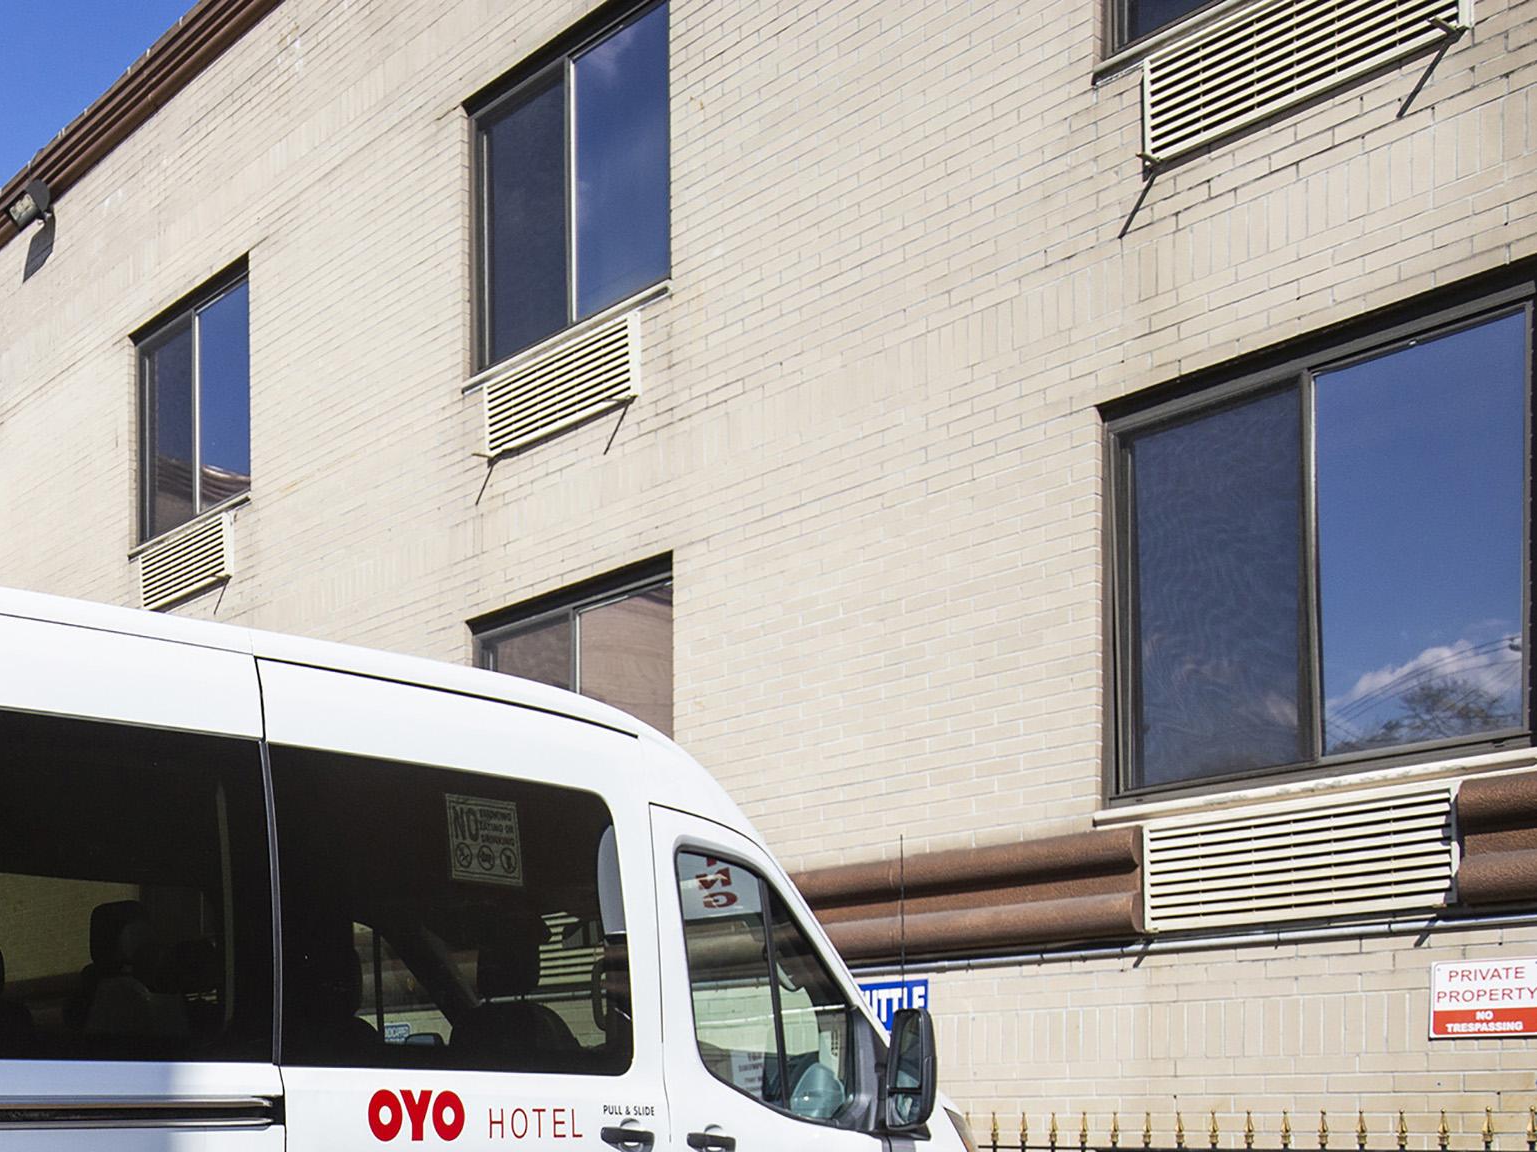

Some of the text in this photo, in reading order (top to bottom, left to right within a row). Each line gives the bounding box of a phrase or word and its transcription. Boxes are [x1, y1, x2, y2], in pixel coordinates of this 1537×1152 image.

[451, 805, 479, 841] NO
[1448, 966, 1526, 982] PRIVATE
[1437, 987, 1537, 1003] PROPERTY
[1475, 1010, 1494, 1020] NO
[1446, 1020, 1523, 1033] TRESPASSING
[368, 1089, 583, 1141] OYO HOTEL
[603, 1104, 655, 1116] PULL & SLIDE
